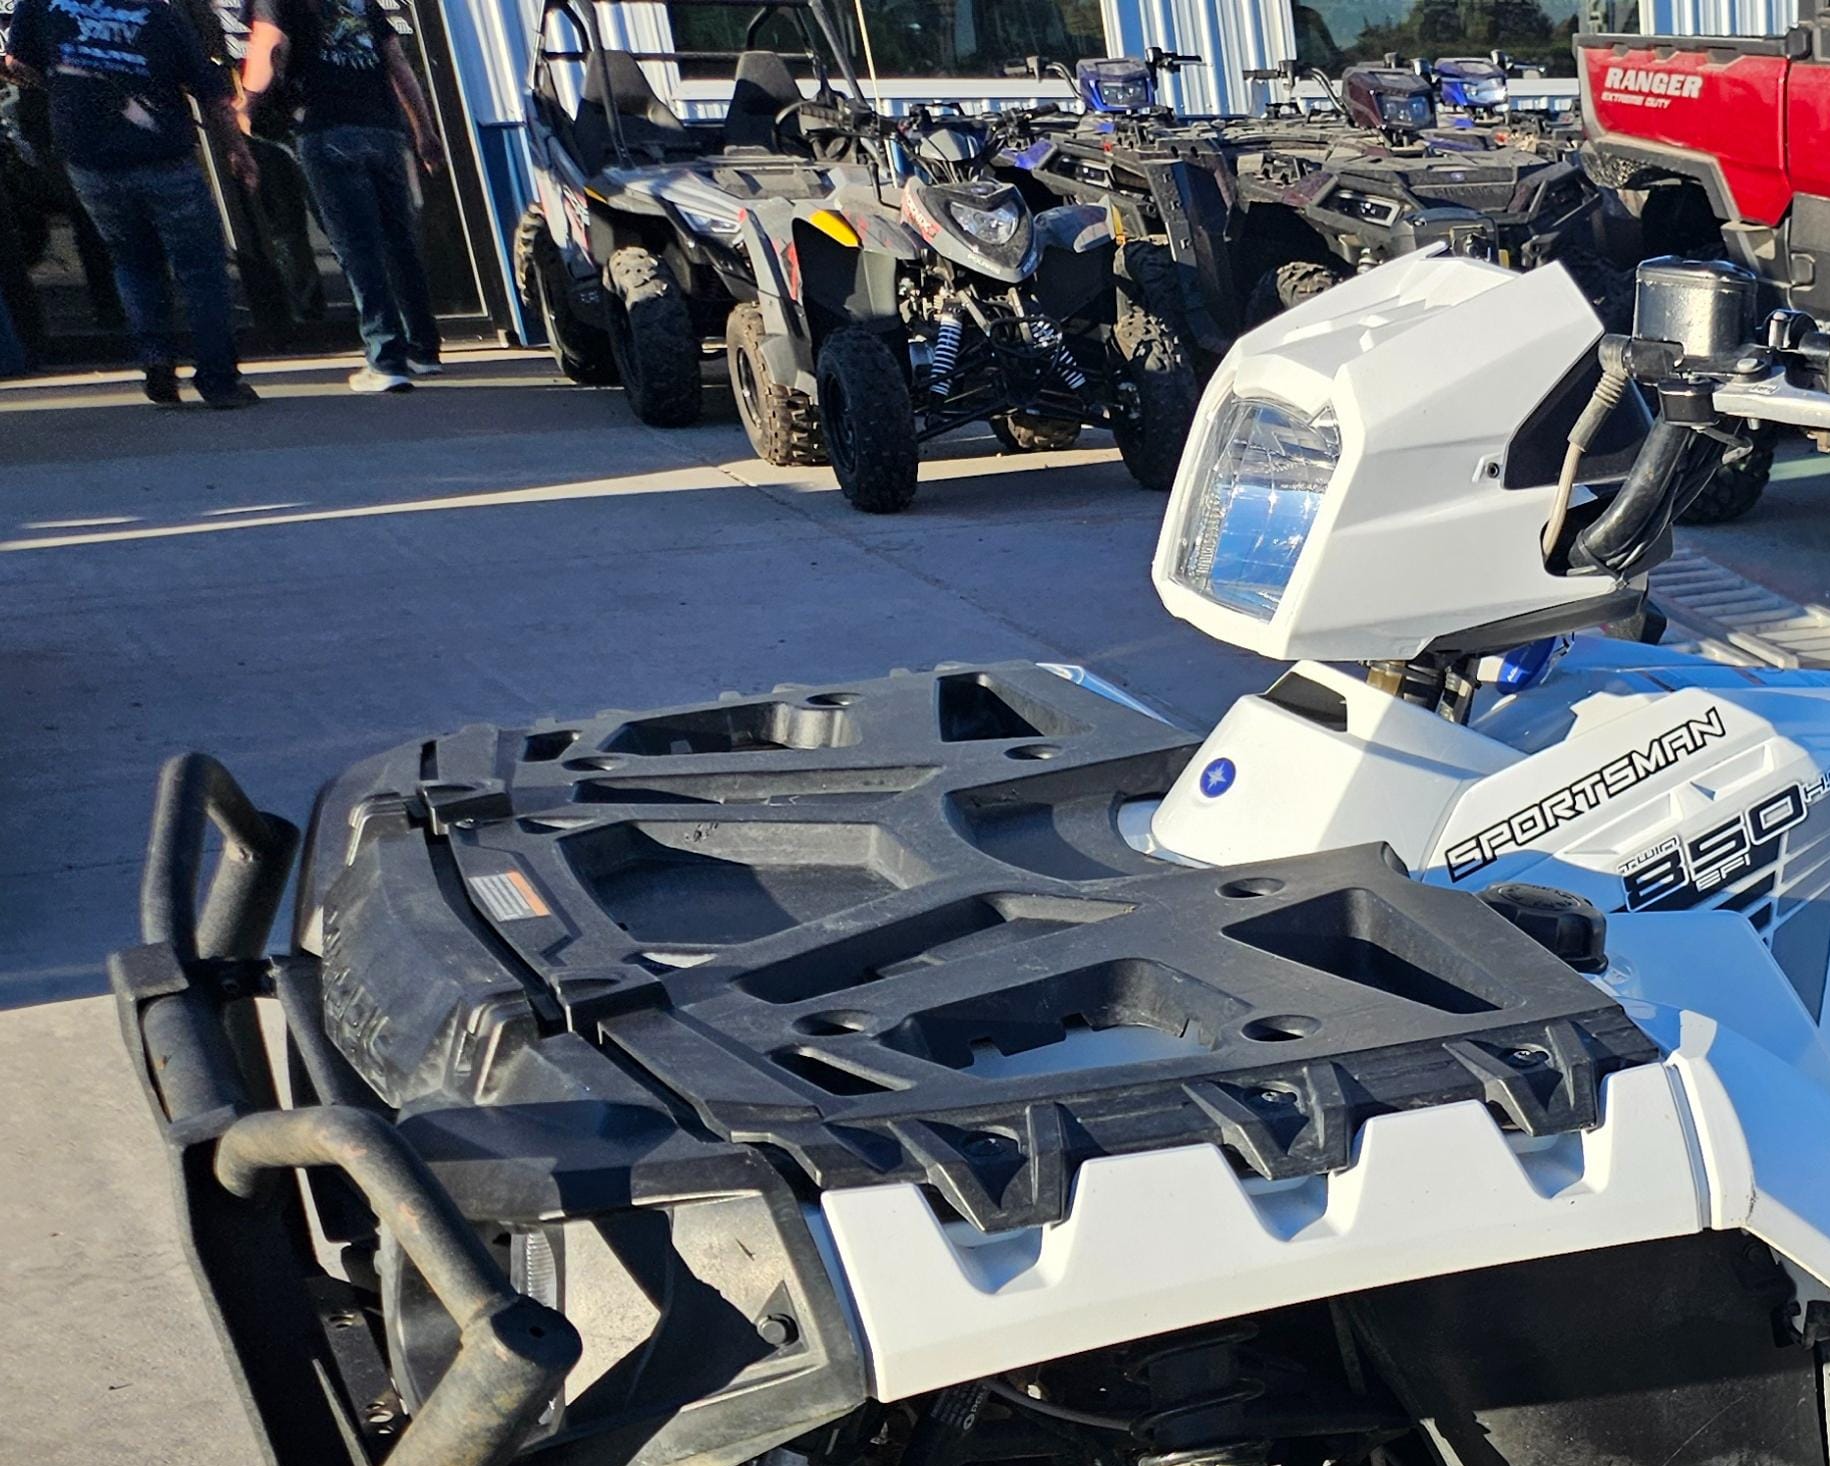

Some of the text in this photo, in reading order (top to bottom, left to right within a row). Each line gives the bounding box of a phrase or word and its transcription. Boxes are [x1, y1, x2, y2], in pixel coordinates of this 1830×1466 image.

[1604, 67, 1703, 98] RANGER
[1445, 706, 1726, 883] SPORTSMAN
[1616, 834, 1682, 874] TWIN
[1622, 782, 1808, 912] 850
[1696, 851, 1752, 892] EFI
